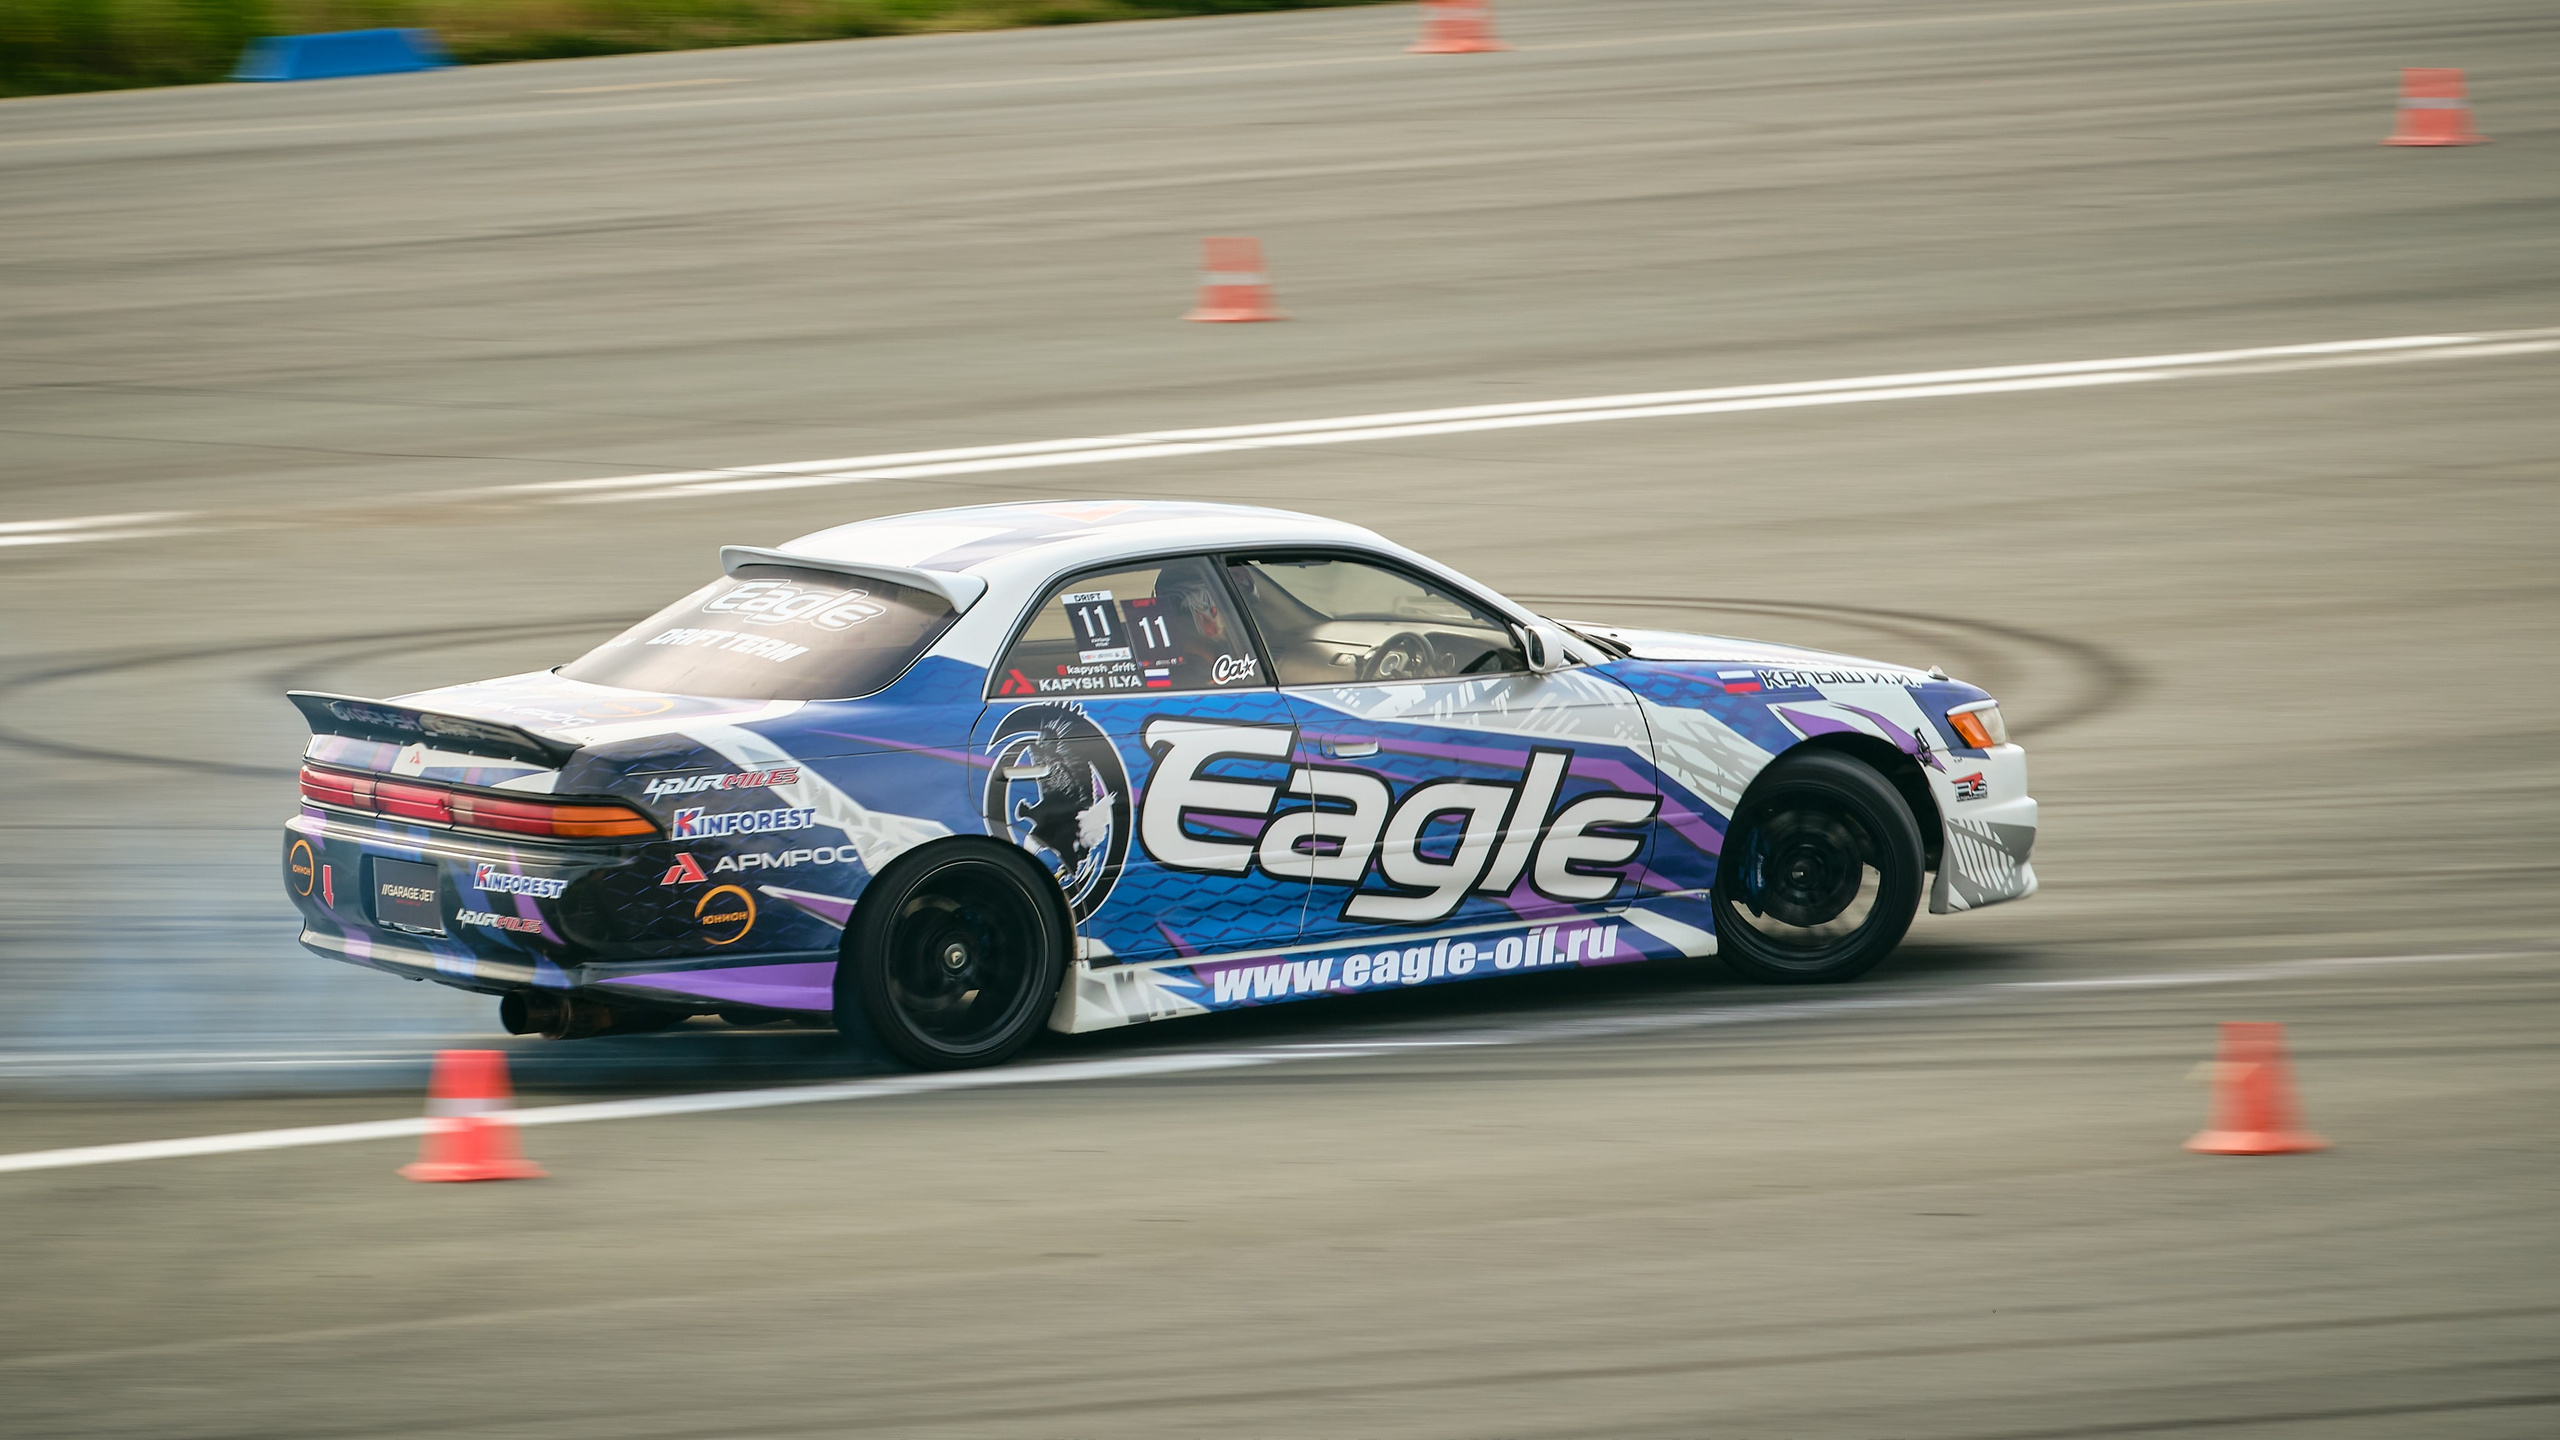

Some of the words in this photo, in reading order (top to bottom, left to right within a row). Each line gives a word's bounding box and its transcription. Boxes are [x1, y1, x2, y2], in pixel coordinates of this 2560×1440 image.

[702, 578, 887, 631] Eagle
[1073, 592, 1102, 602] DRIFT
[1078, 604, 1112, 638] 11
[1138, 614, 1172, 649] 11
[645, 628, 738, 647] DRIFT
[1039, 676, 1105, 692] KAPYSH
[1108, 674, 1143, 689] ILYA
[1758, 669, 1866, 690] КАПЫШ
[1136, 714, 1662, 923] Eagle
[712, 845, 859, 874] АРМРОС
[420, 889, 436, 902] JET
[702, 911, 748, 926] ЮНИОН
[1213, 924, 1619, 1003] www.eagle-oil.ru
